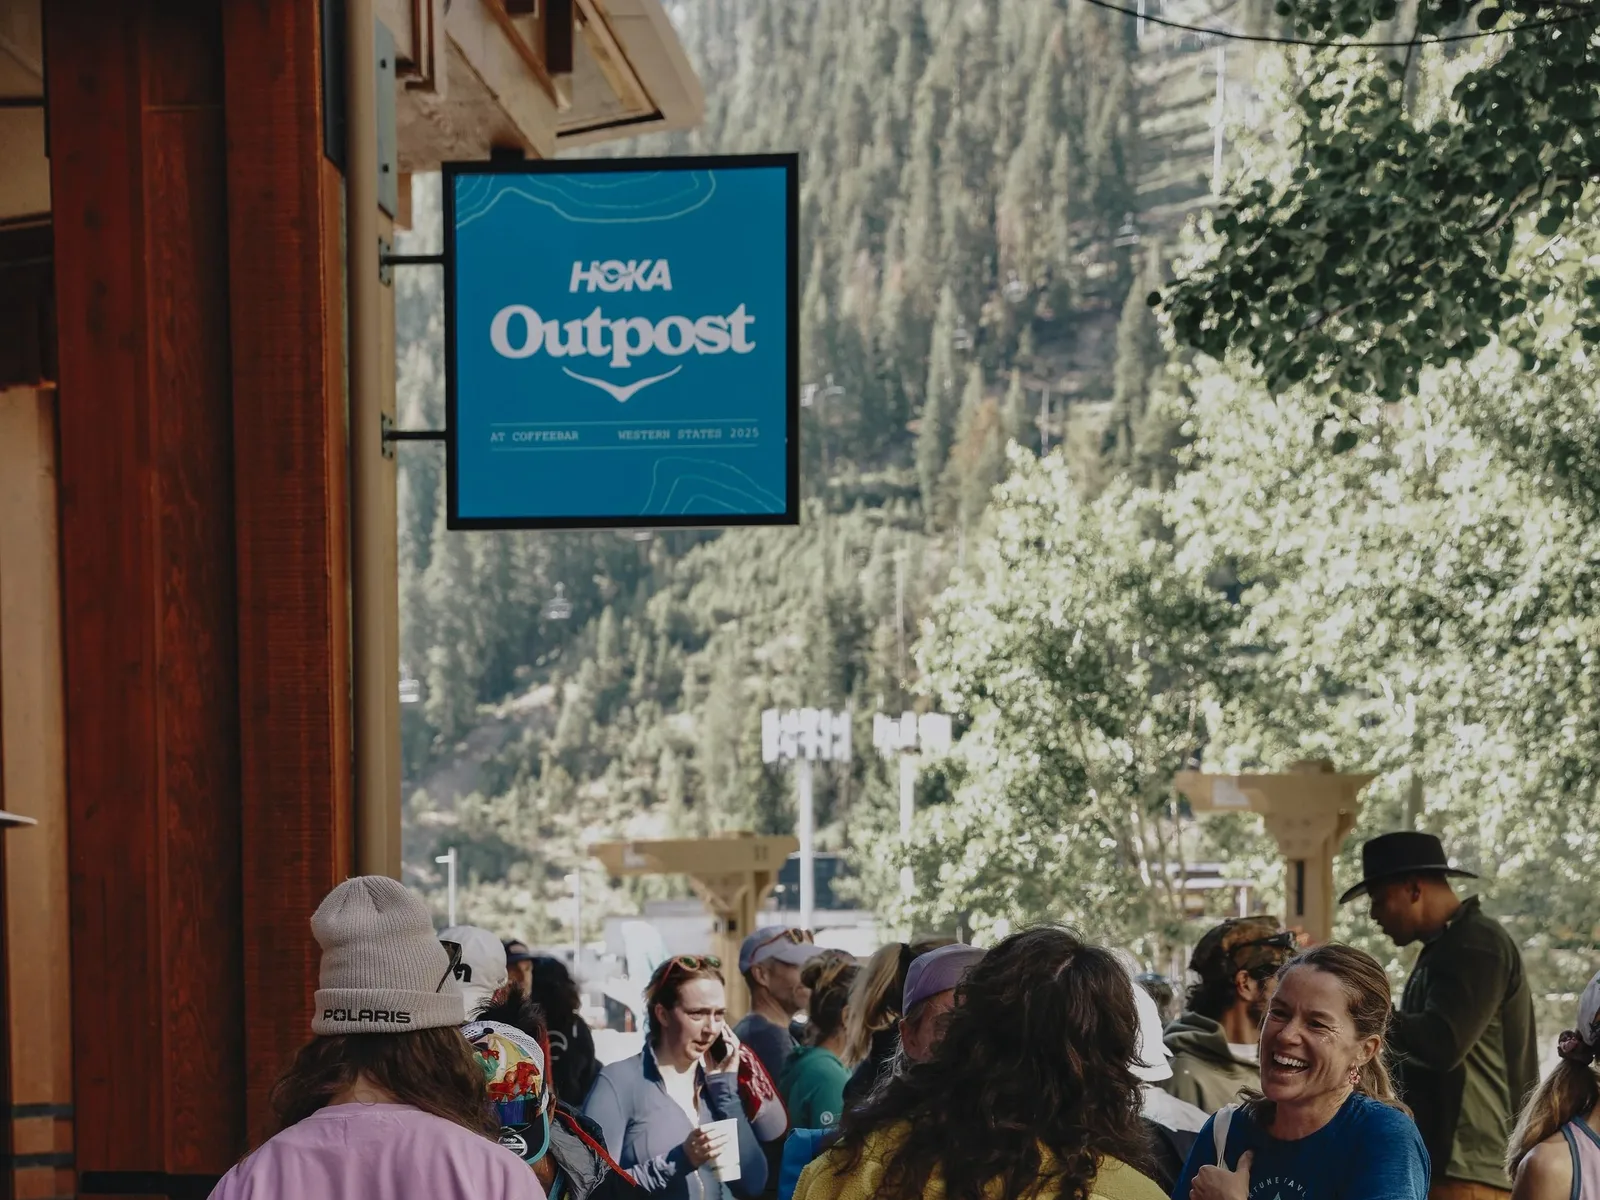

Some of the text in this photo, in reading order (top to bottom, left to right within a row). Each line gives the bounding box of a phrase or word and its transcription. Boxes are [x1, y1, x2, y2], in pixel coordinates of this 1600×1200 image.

[569, 259, 673, 293] HOKA
[490, 303, 756, 367] Outpost
[490, 430, 579, 443] AT COFFEEBAR
[618, 427, 759, 441] WESTERN STATES 2025
[323, 1009, 411, 1024] POLARIS
